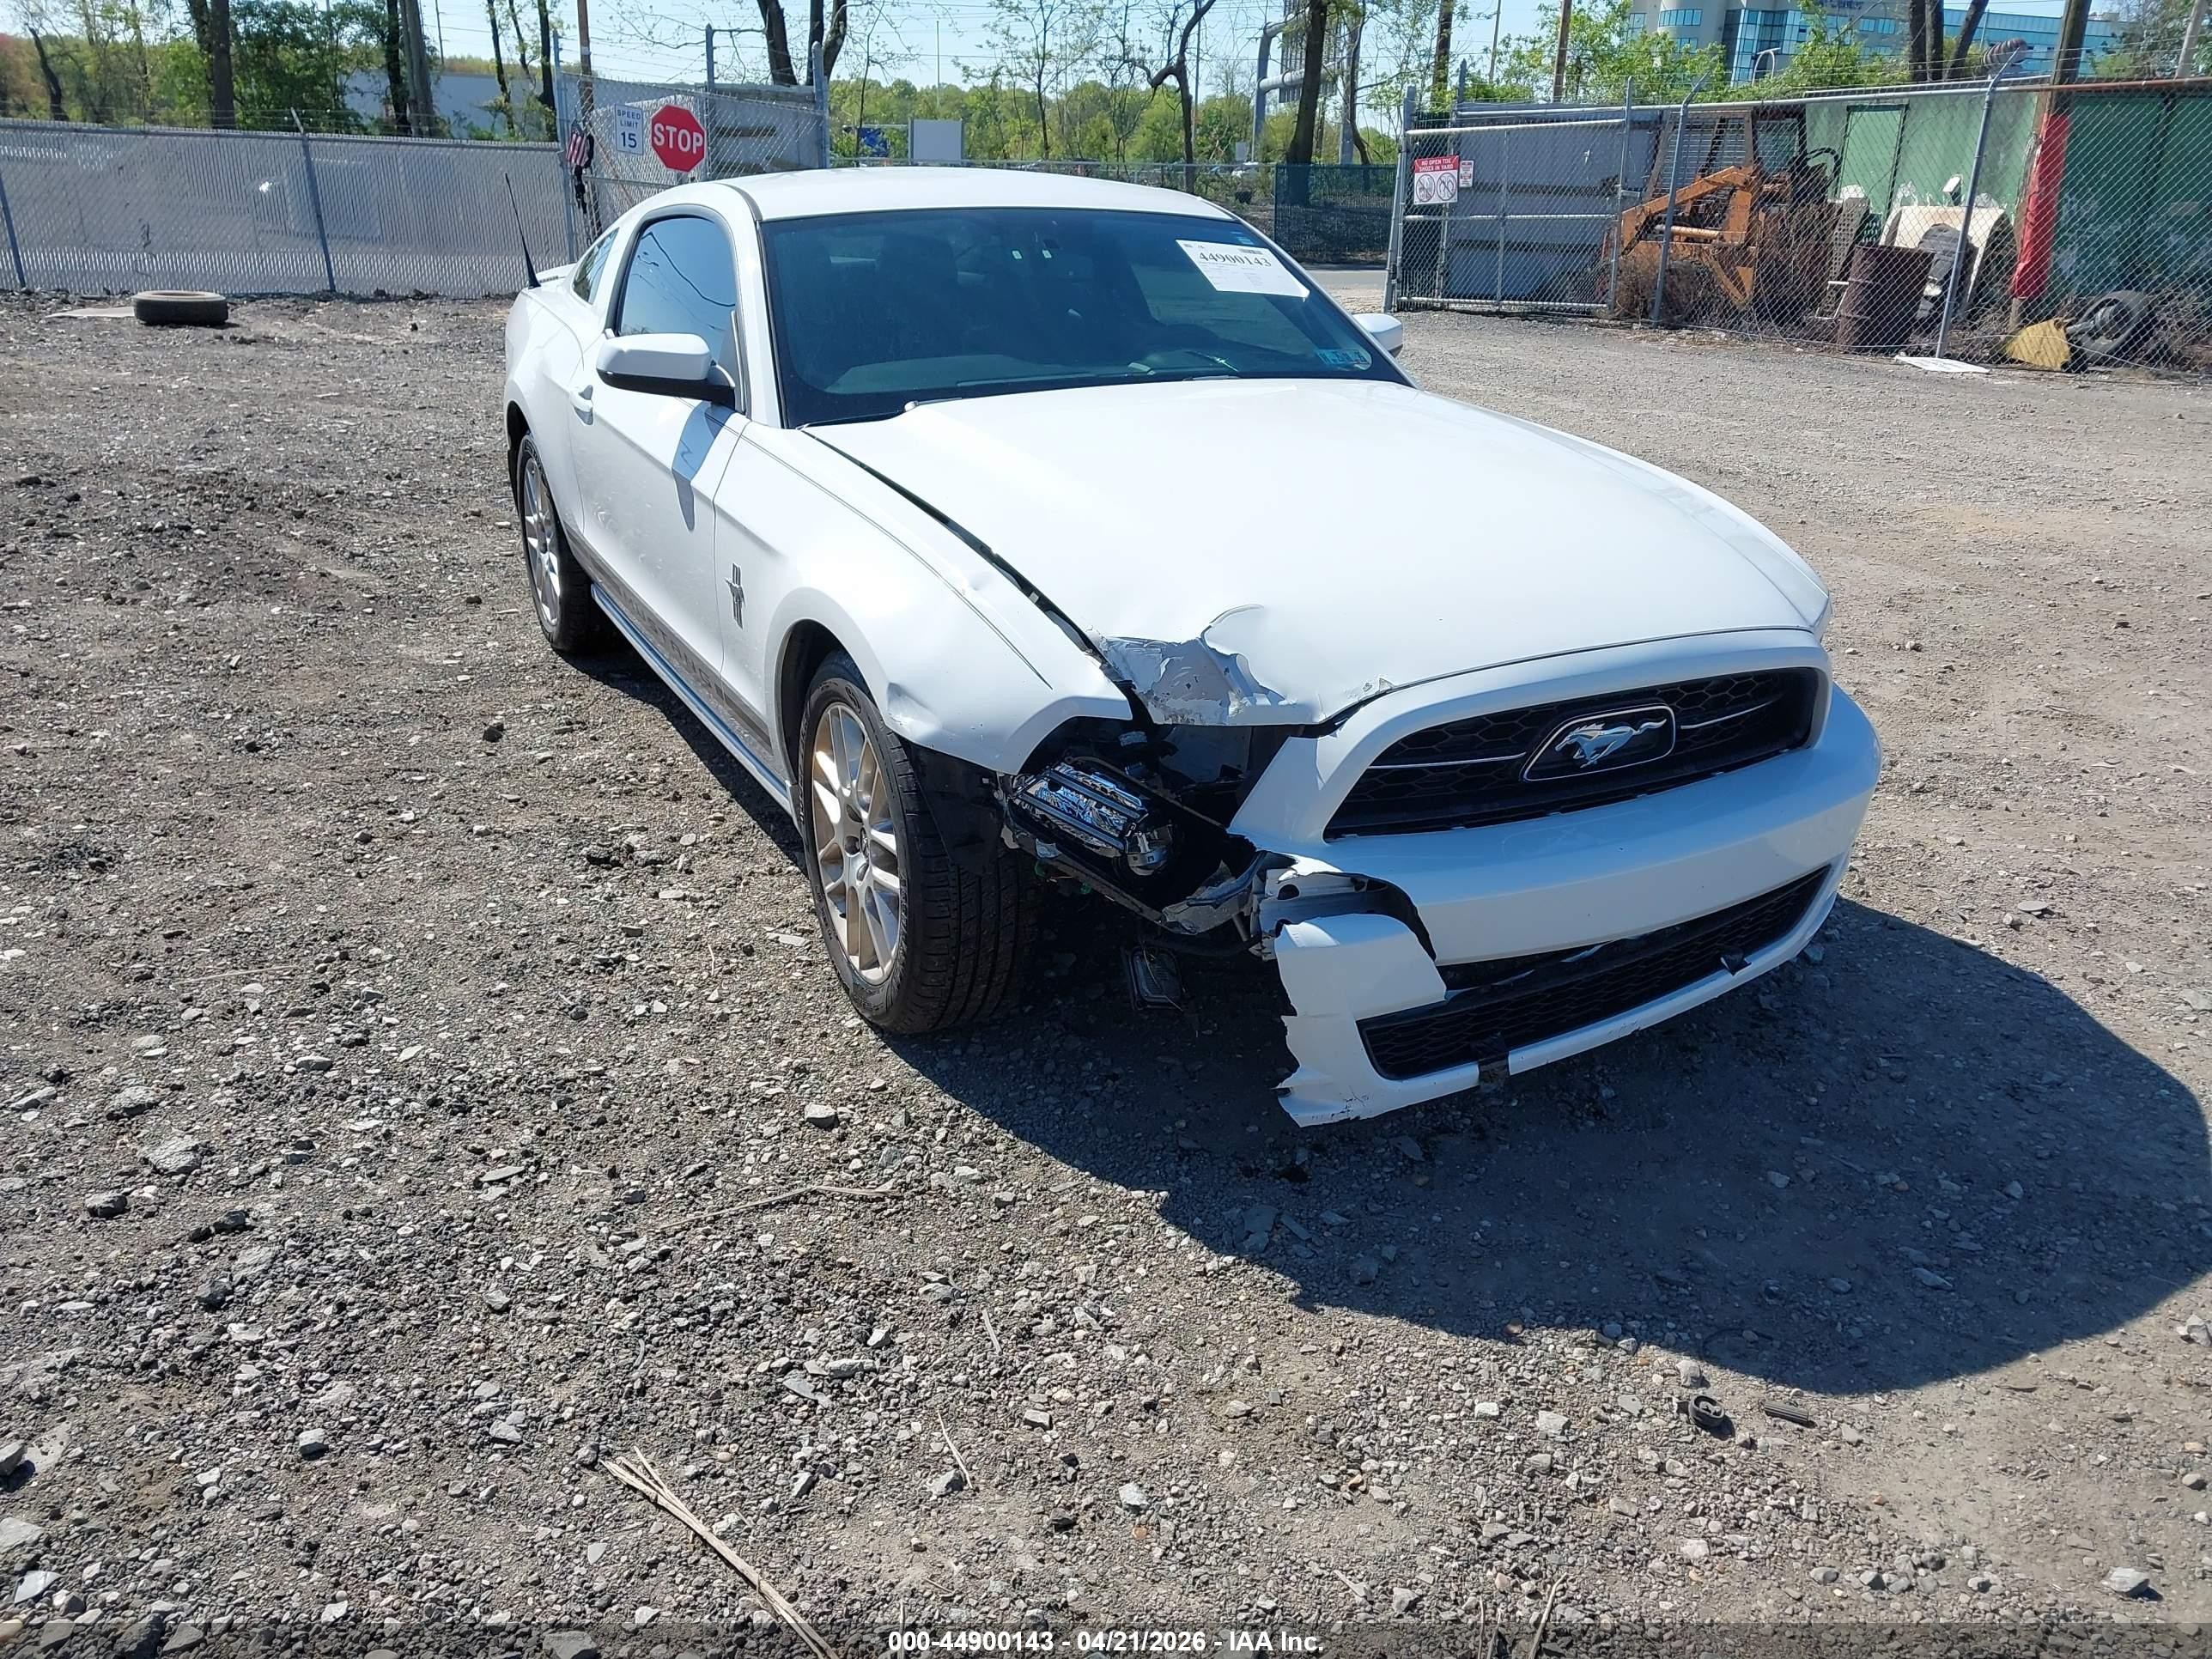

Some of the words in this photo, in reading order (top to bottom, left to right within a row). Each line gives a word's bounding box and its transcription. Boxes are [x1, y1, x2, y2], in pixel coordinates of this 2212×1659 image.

[617, 109, 641, 120] SPEED
[620, 120, 639, 129] LIMIT
[620, 131, 637, 149] 15
[653, 123, 703, 155] STOP
[1199, 252, 1272, 267] 44900143
